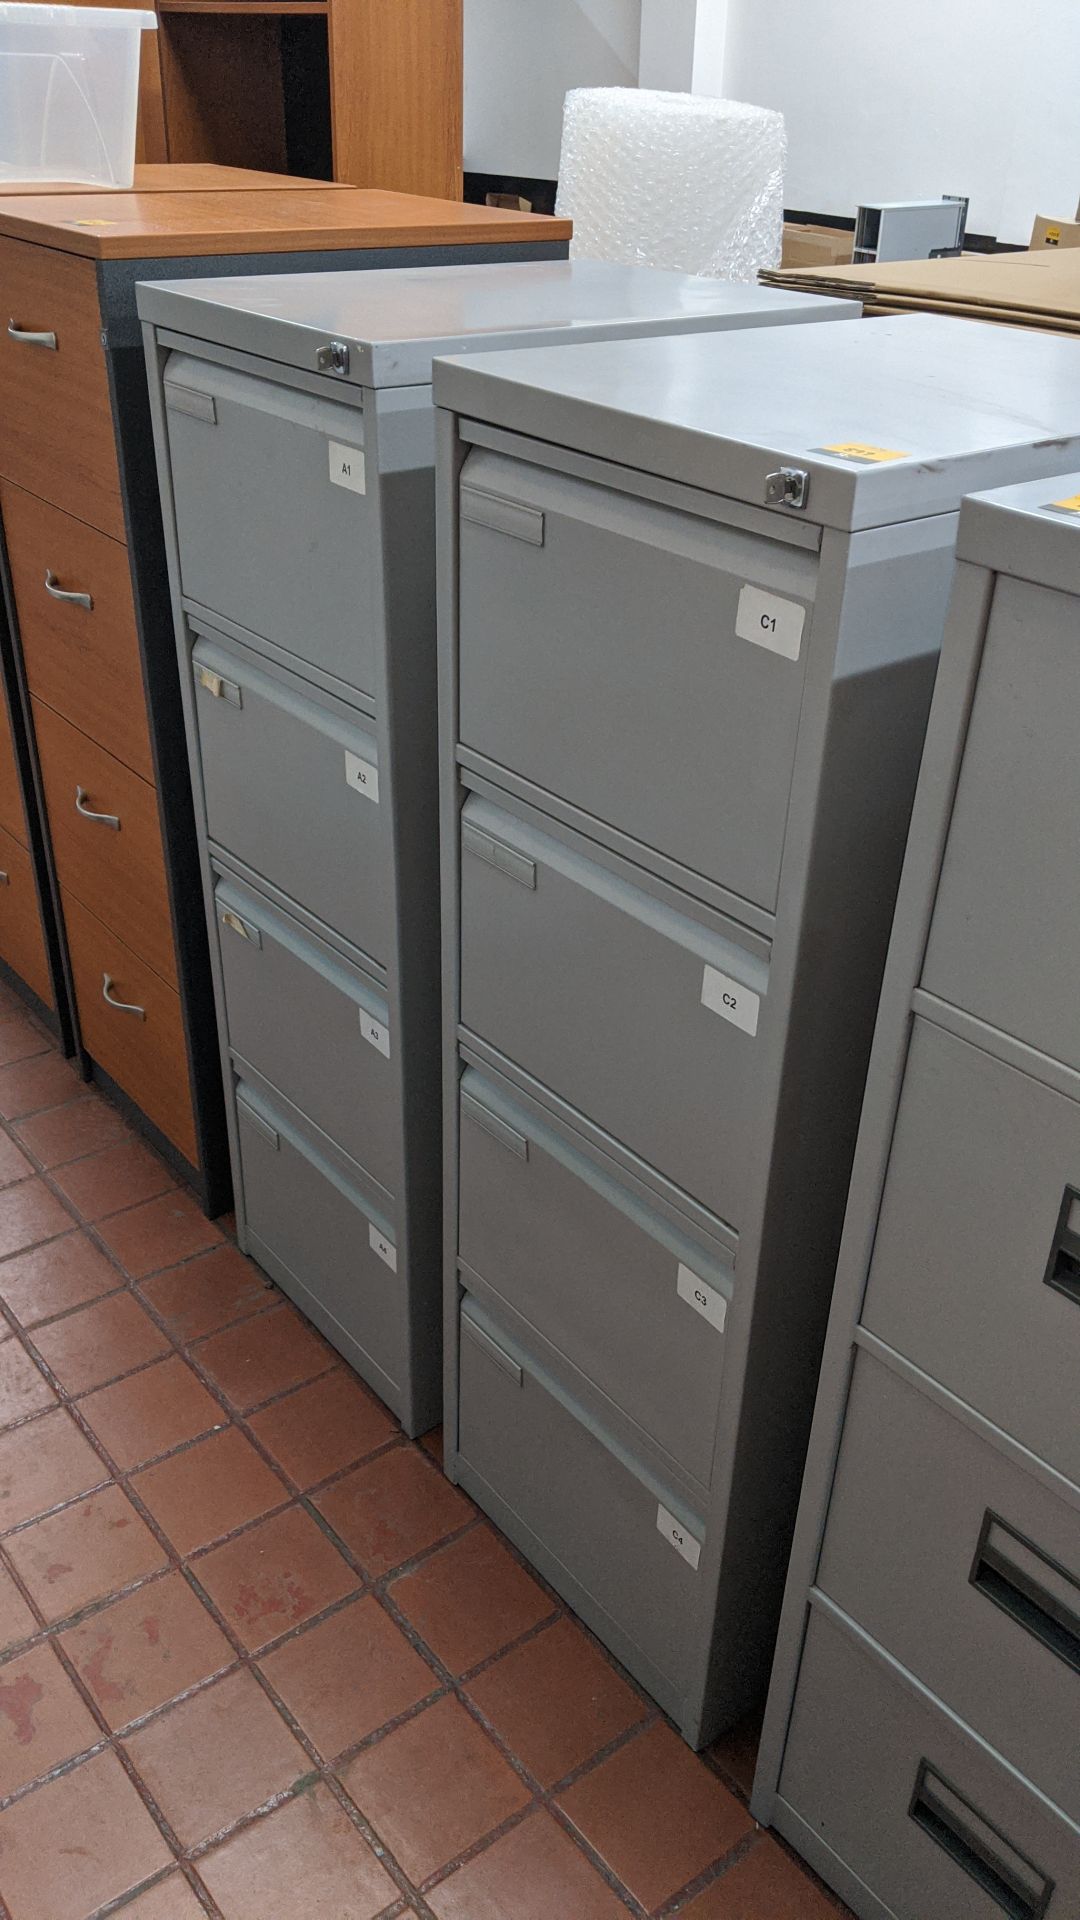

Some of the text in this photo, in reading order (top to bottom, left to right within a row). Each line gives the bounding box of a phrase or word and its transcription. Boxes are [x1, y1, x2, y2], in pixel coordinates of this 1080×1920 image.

[342, 463, 351, 476] A1
[760, 614, 776, 632] C1
[357, 771, 367, 785] A2
[722, 993, 737, 1010] C2
[694, 1290, 707, 1306] C3
[672, 1530, 683, 1546] C4
